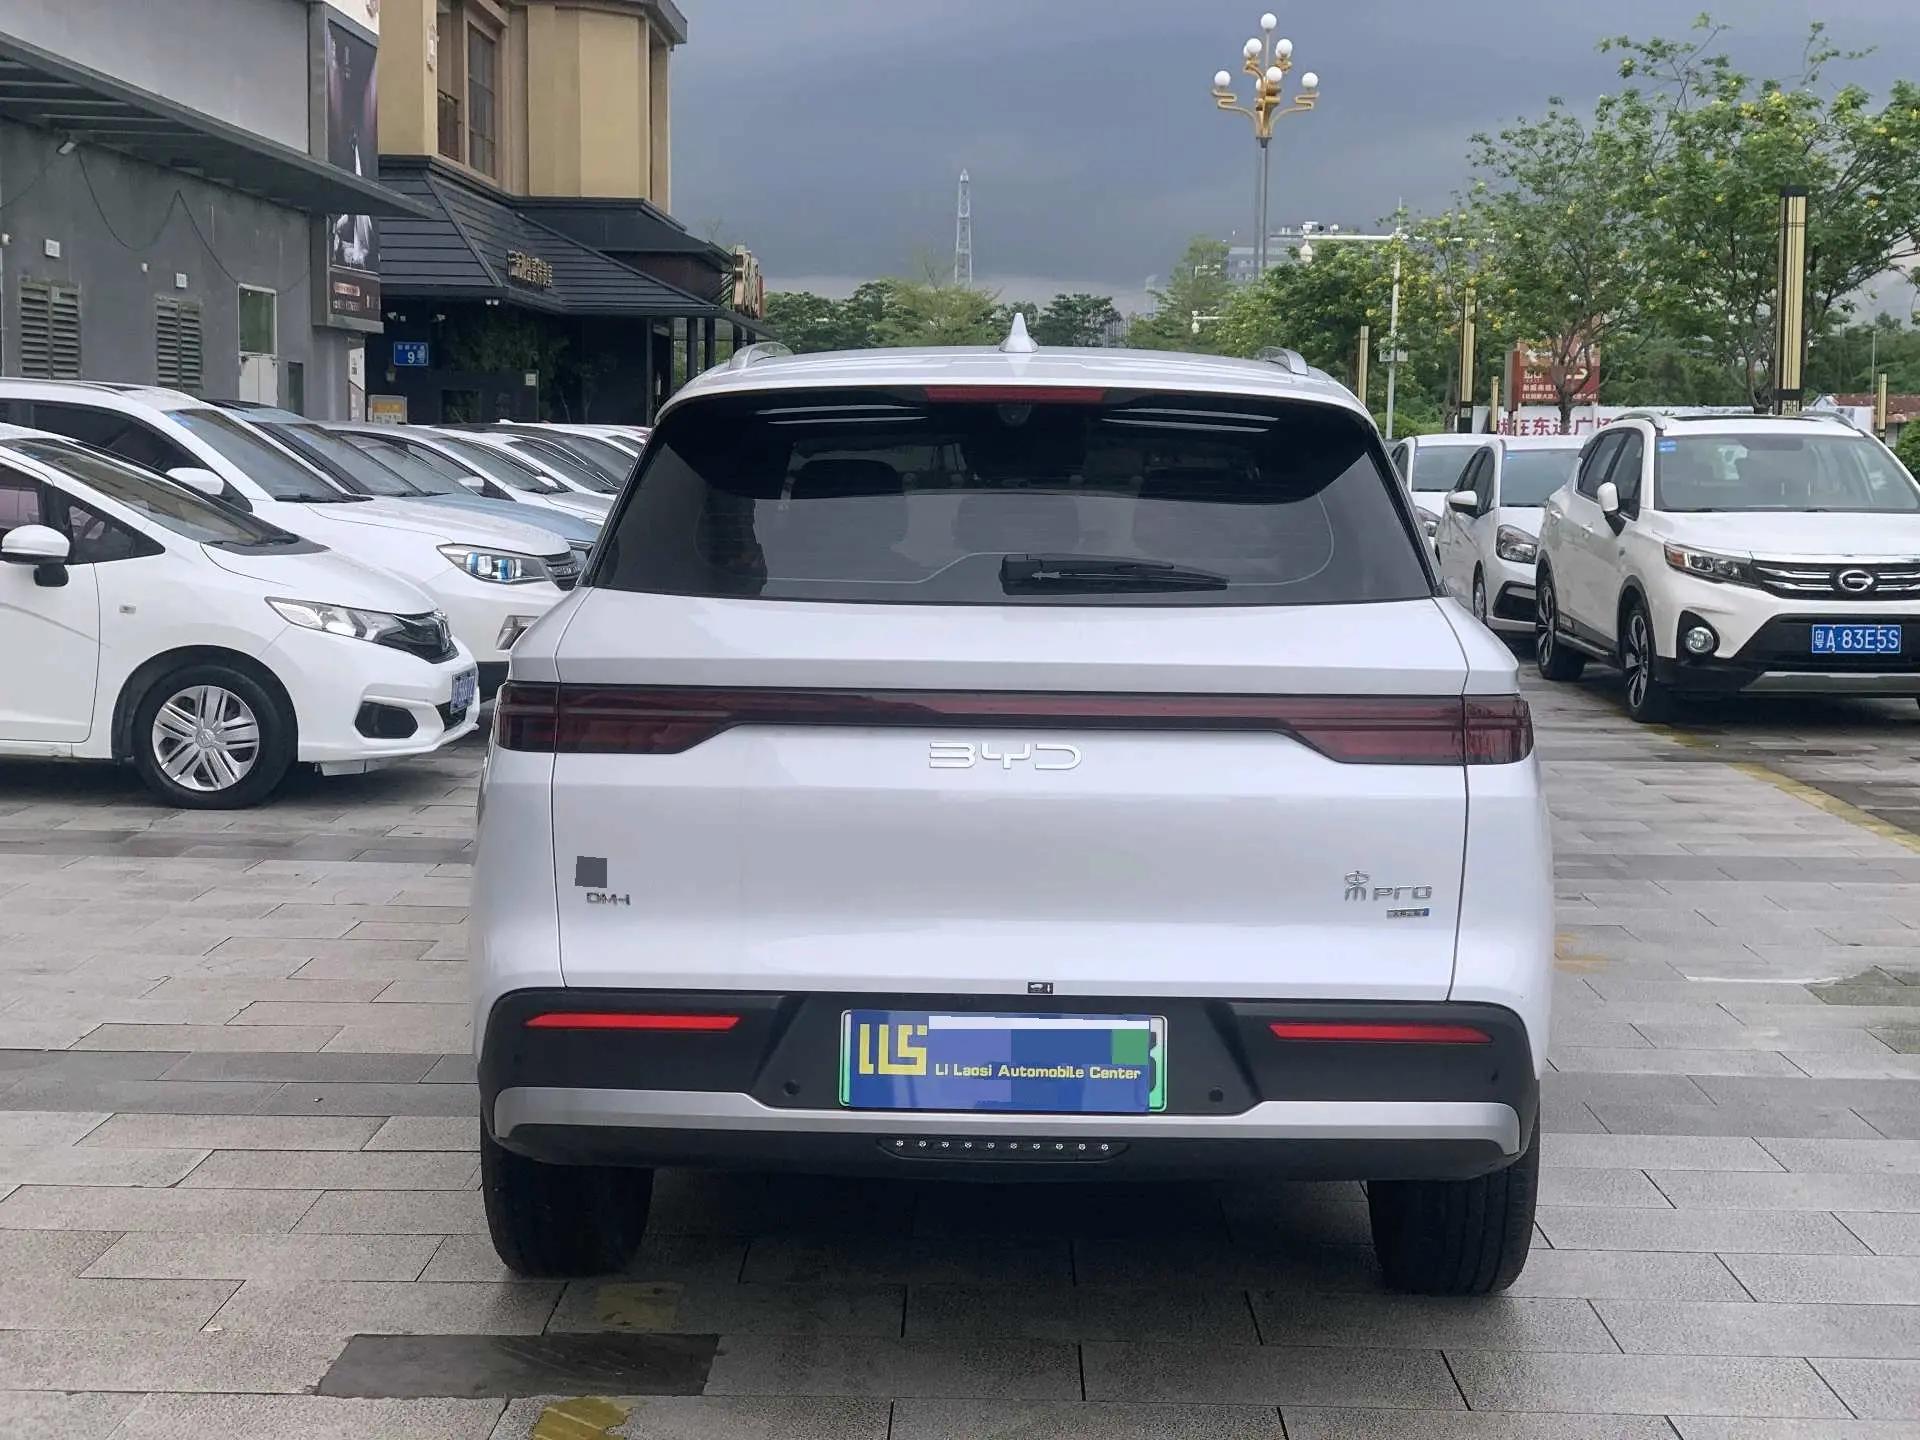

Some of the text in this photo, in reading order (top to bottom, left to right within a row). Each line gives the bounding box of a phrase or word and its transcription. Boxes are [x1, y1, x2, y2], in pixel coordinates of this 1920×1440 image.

[407, 351, 416, 364] 9
[929, 742, 1083, 770] BYD
[953, 1063, 993, 1077] Laosi
[998, 1064, 1085, 1079] Automobile
[1089, 1066, 1142, 1080] Center
